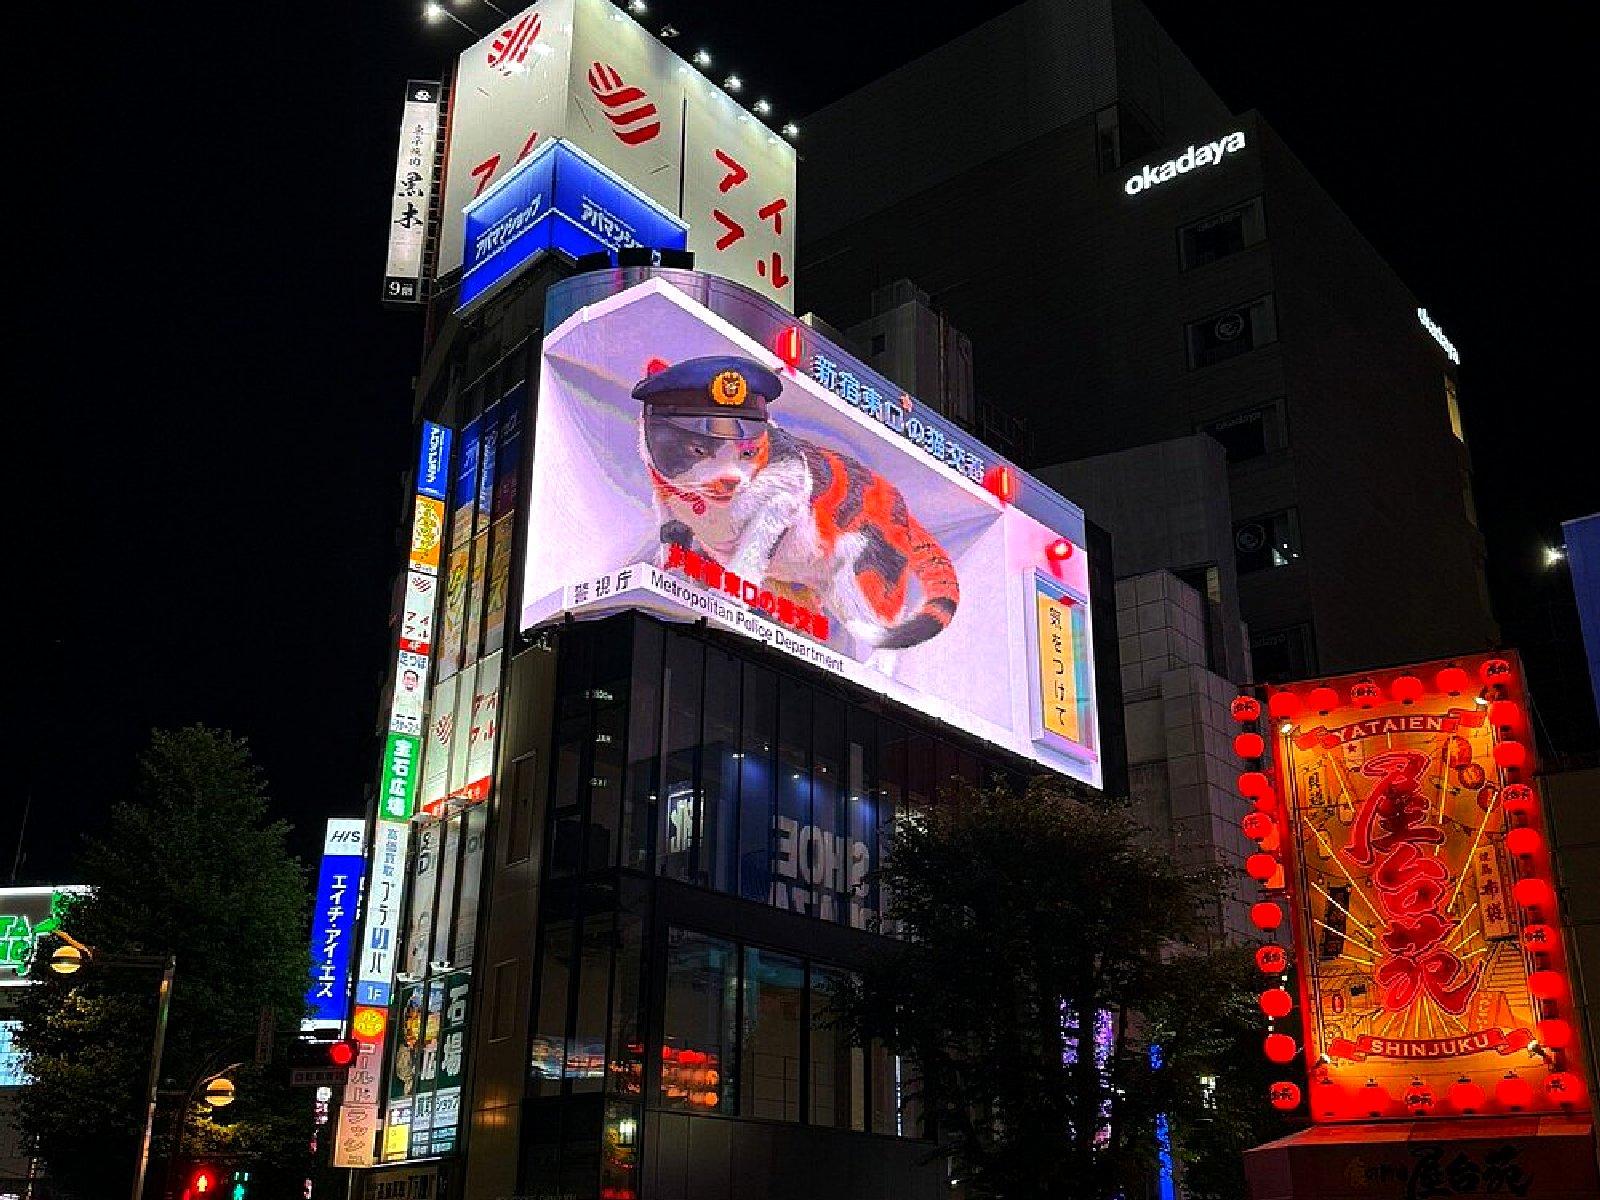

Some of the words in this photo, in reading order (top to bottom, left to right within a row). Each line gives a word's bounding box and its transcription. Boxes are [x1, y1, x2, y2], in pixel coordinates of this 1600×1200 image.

[1125, 130, 1246, 196] okadaya
[574, 569, 633, 605] 警視庁
[651, 570, 735, 623] Metropolitan
[735, 611, 774, 641] Police
[775, 629, 846, 673] Department
[1332, 715, 1444, 746] YATAIEN
[1370, 1035, 1491, 1058] SHINJUKU
